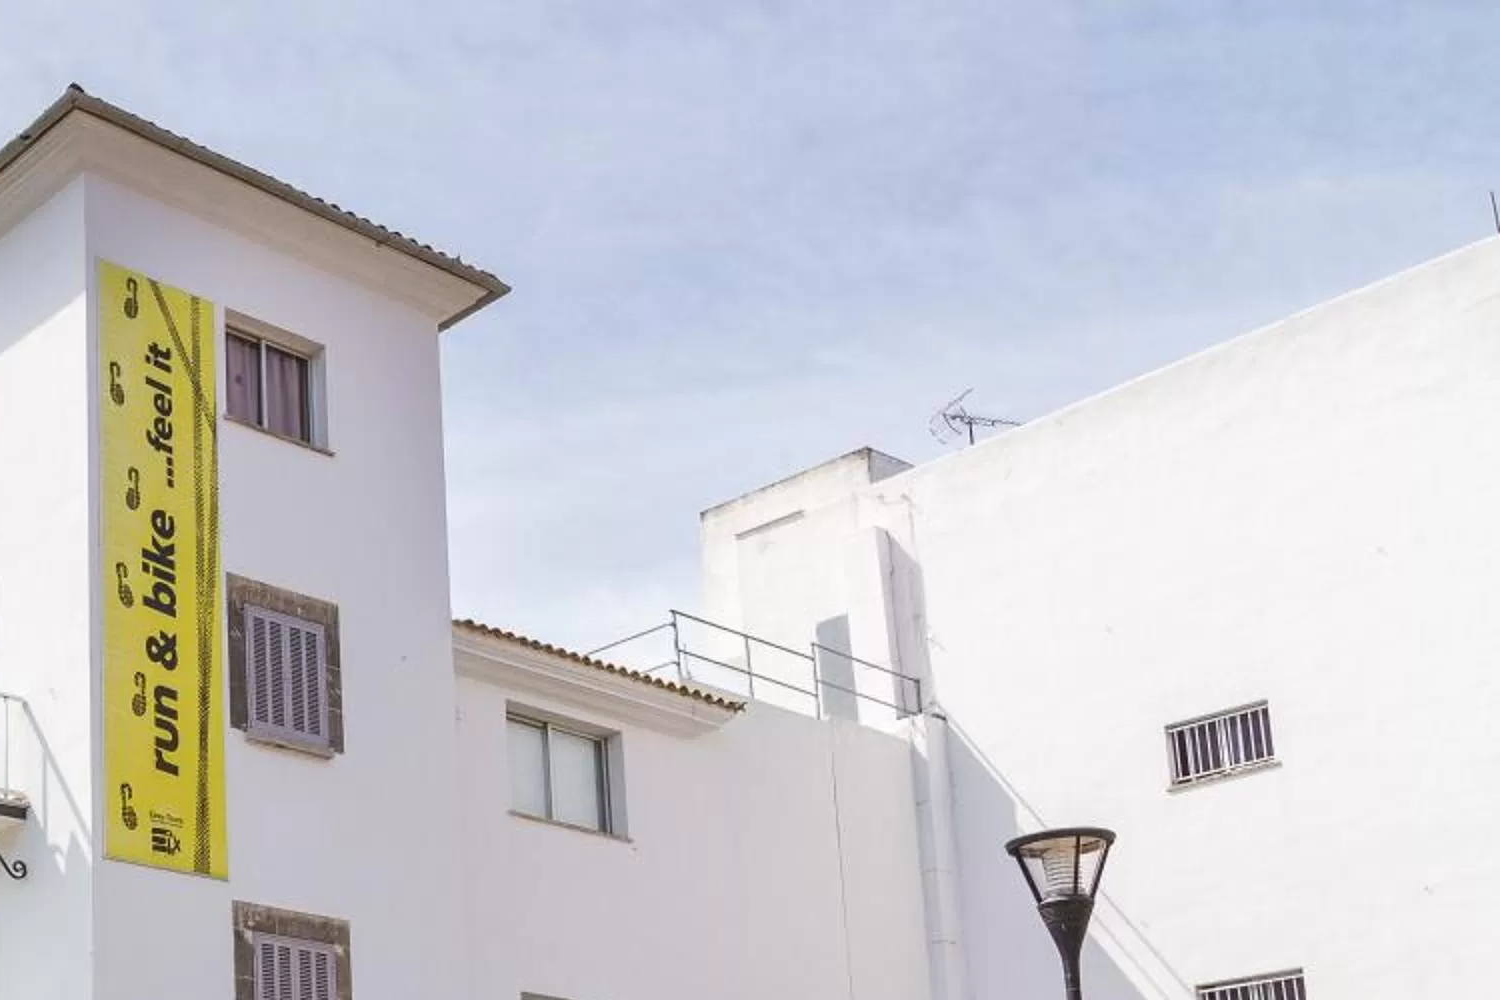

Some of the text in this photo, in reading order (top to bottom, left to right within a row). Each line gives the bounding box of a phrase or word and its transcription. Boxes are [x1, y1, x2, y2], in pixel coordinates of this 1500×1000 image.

[145, 341, 172, 374] it
[141, 508, 177, 619] bike
[145, 630, 178, 671] &
[154, 684, 180, 778] run
